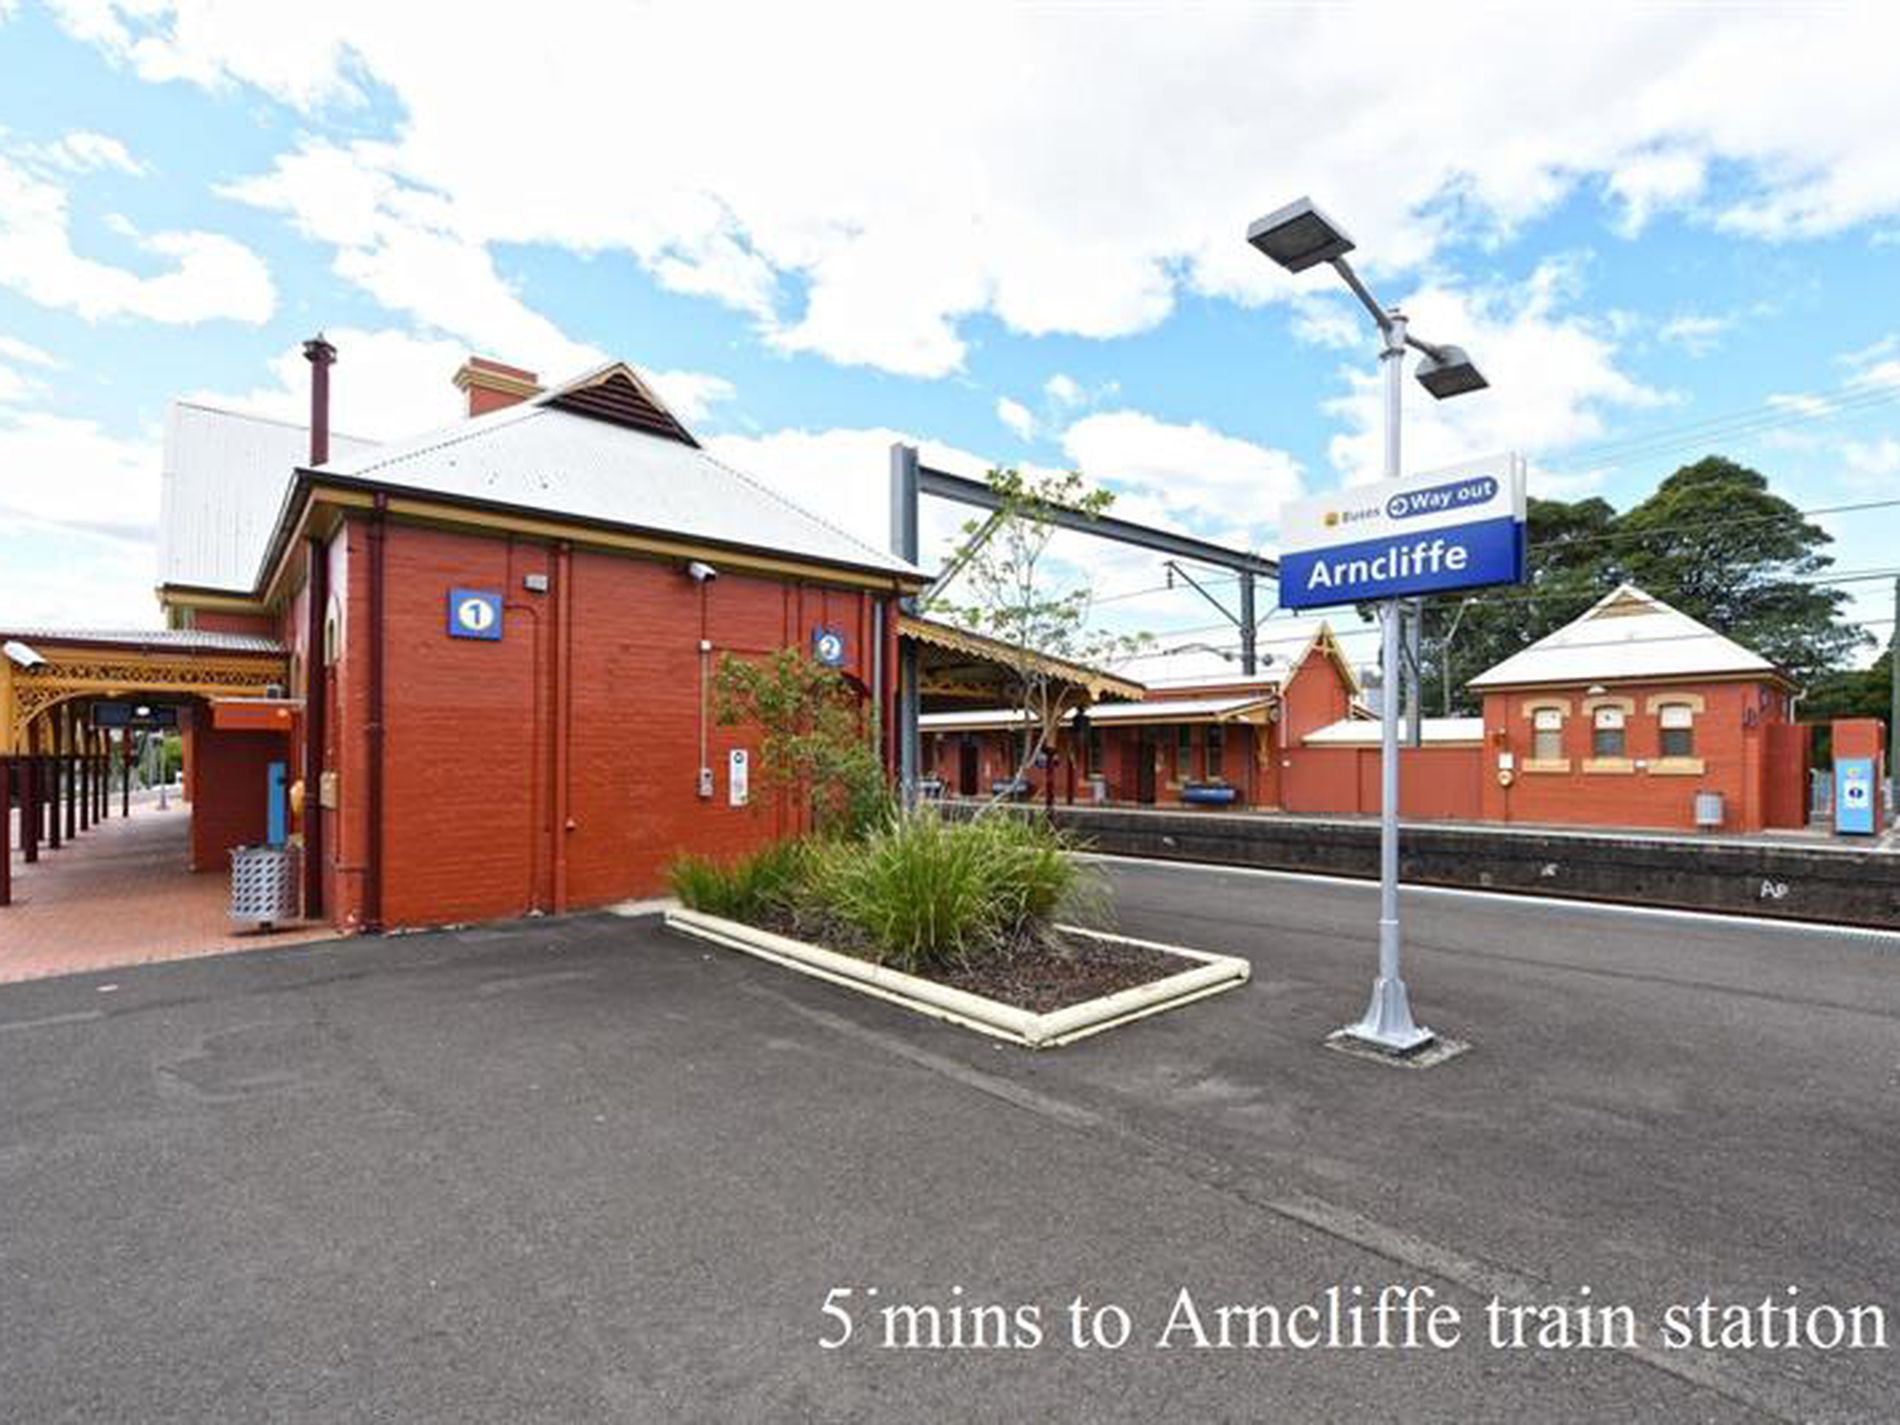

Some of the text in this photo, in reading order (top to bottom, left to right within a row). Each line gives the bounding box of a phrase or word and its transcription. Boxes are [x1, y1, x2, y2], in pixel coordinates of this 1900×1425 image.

[1410, 482, 1492, 509] Way out
[1308, 540, 1467, 589] Arncliffe
[469, 604, 481, 626] 1
